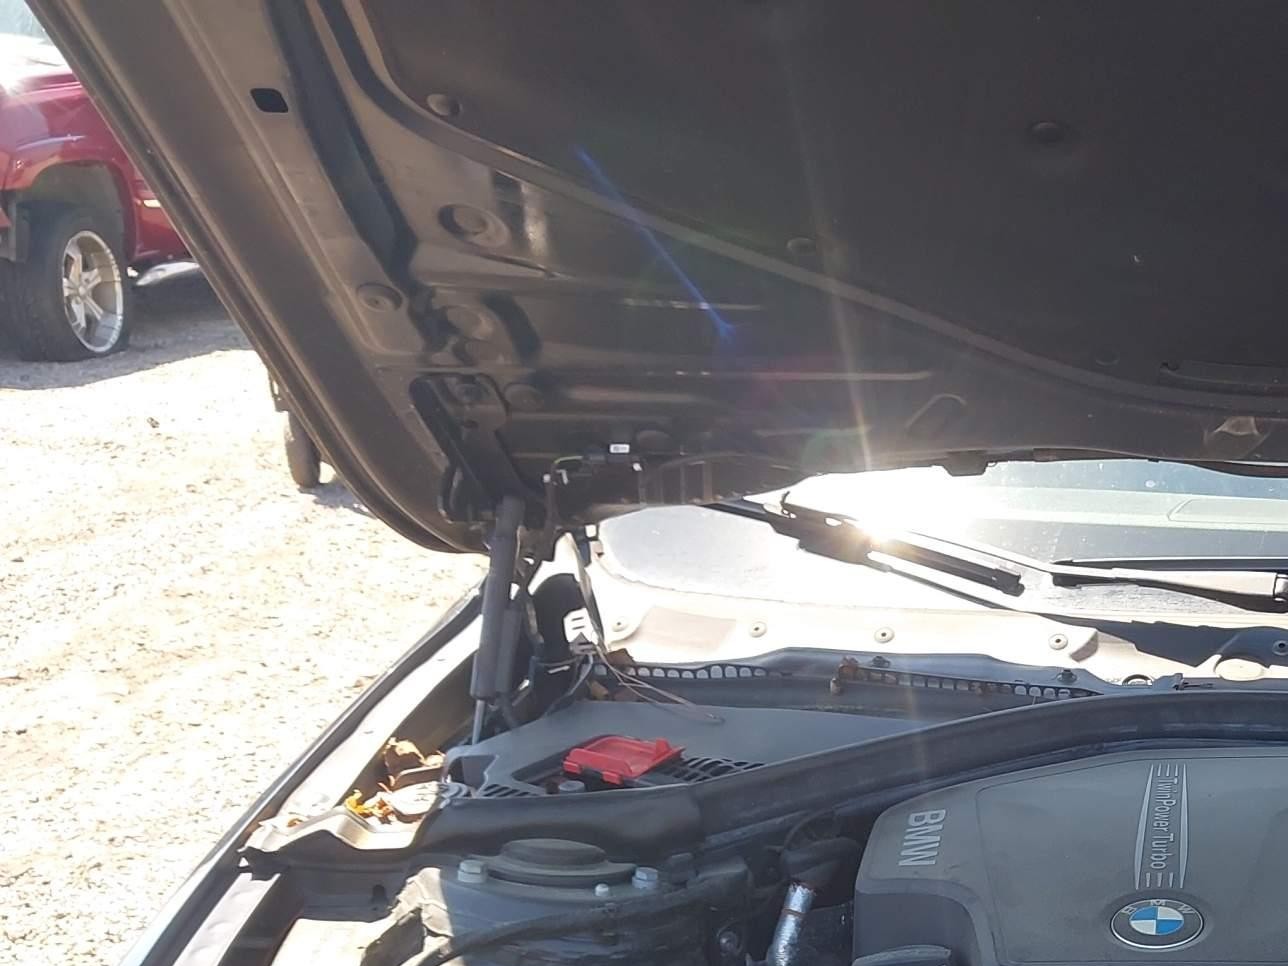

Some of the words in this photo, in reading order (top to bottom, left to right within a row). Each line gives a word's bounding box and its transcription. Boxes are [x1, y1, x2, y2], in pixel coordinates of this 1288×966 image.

[1152, 777, 1178, 832] TwinPower
[898, 809, 946, 866] BMW
[1150, 833, 1174, 869] Turbo
[1120, 899, 1196, 916] BMW
